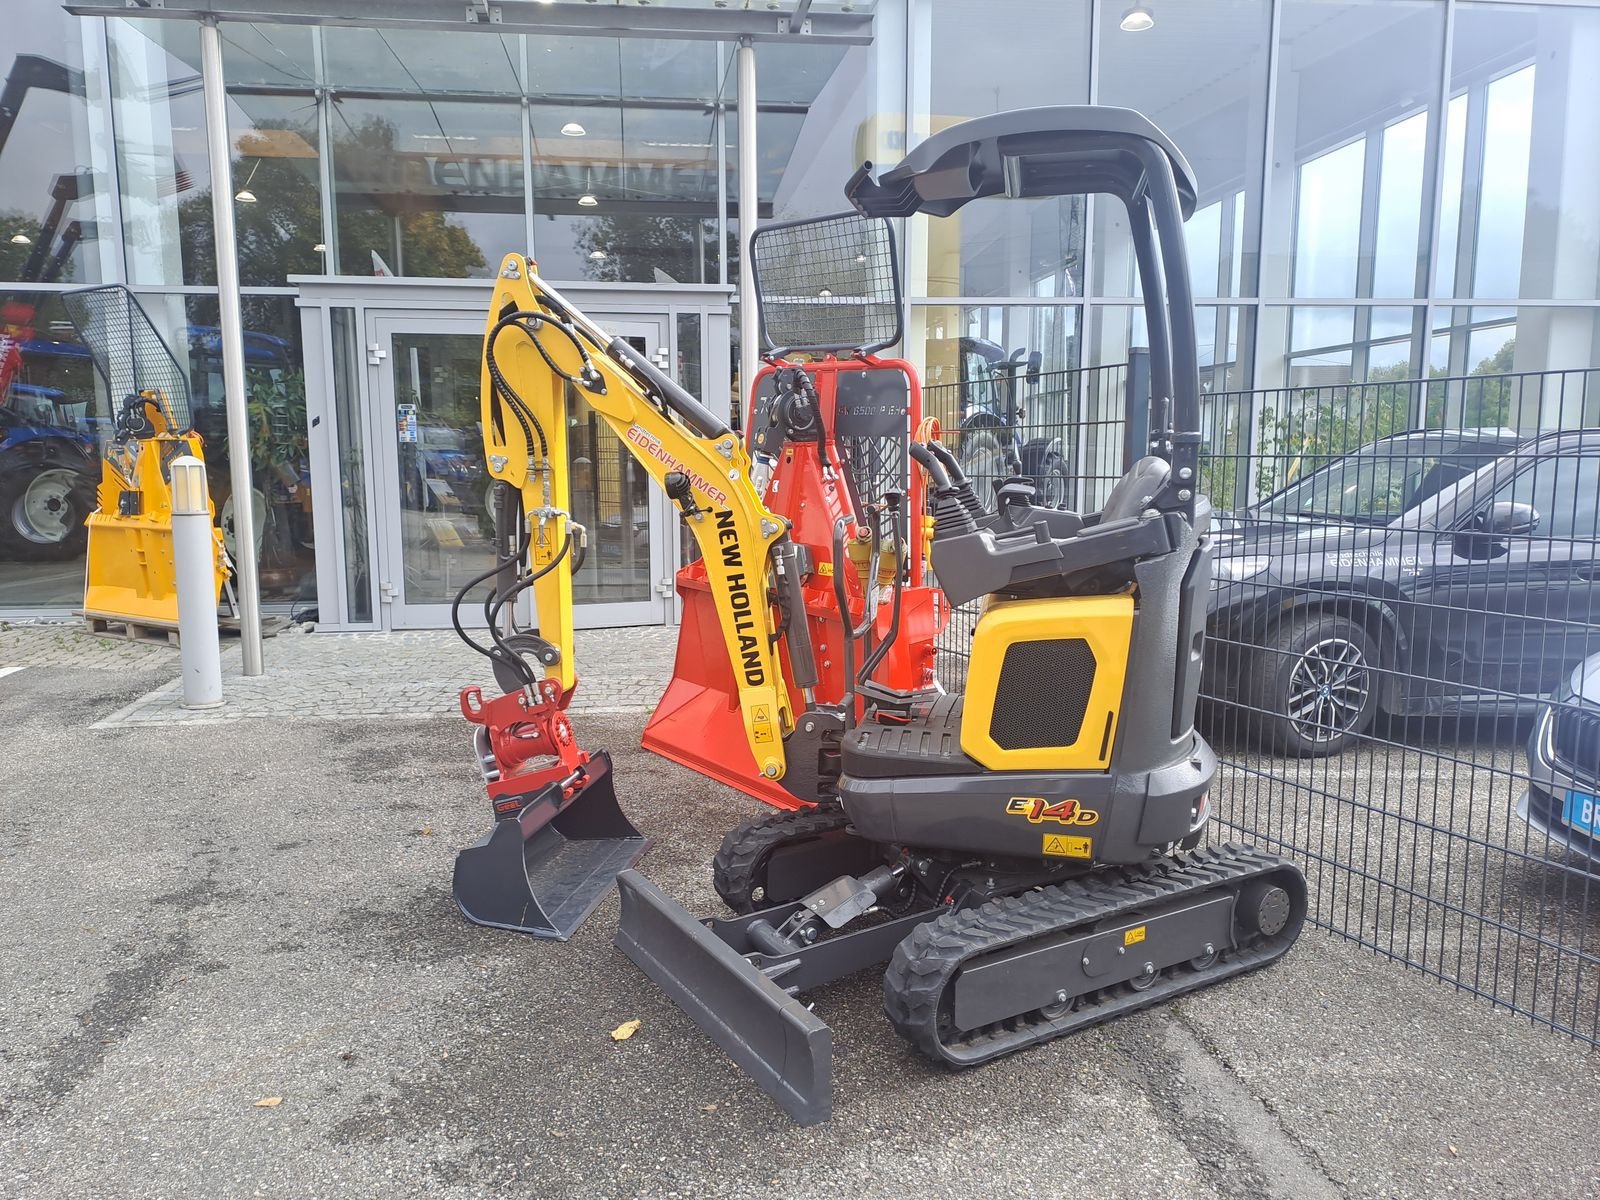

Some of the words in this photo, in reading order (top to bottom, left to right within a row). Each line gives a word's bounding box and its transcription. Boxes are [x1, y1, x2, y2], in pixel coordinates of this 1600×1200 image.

[627, 427, 727, 506] EIDENHAMMER
[715, 510, 743, 567] NEW
[726, 573, 765, 687] HOLLAND
